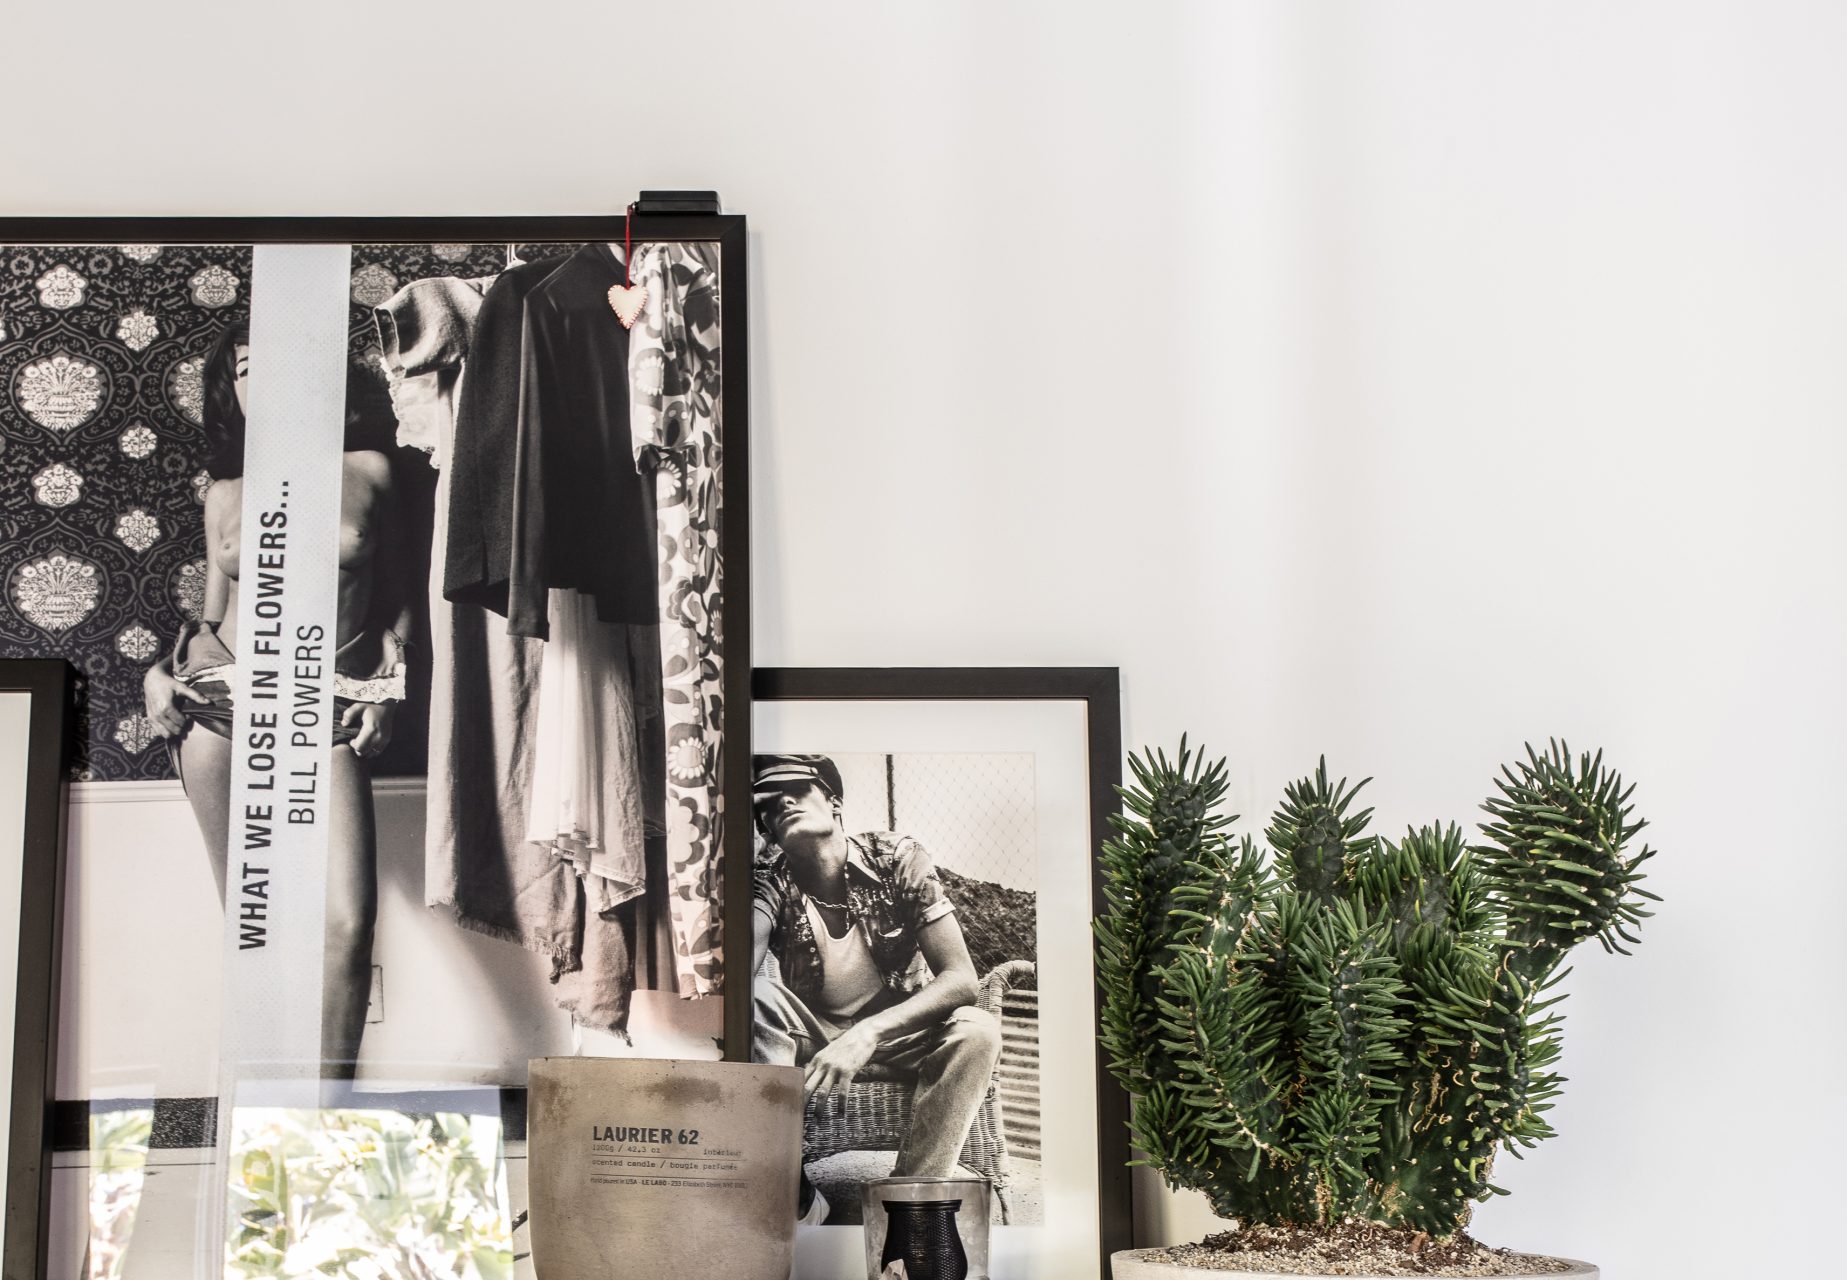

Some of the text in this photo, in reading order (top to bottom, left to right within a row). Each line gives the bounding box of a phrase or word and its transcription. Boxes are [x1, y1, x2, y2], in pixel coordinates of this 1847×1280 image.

[238, 480, 290, 950] WHAT WE LOSE IN FLOWERS...
[288, 624, 325, 825] BILL POWERS
[592, 1125, 699, 1145] LAURIER 62
[592, 1159, 623, 1167] scented
[627, 1160, 656, 1168] candle
[670, 1162, 699, 1171] bougie
